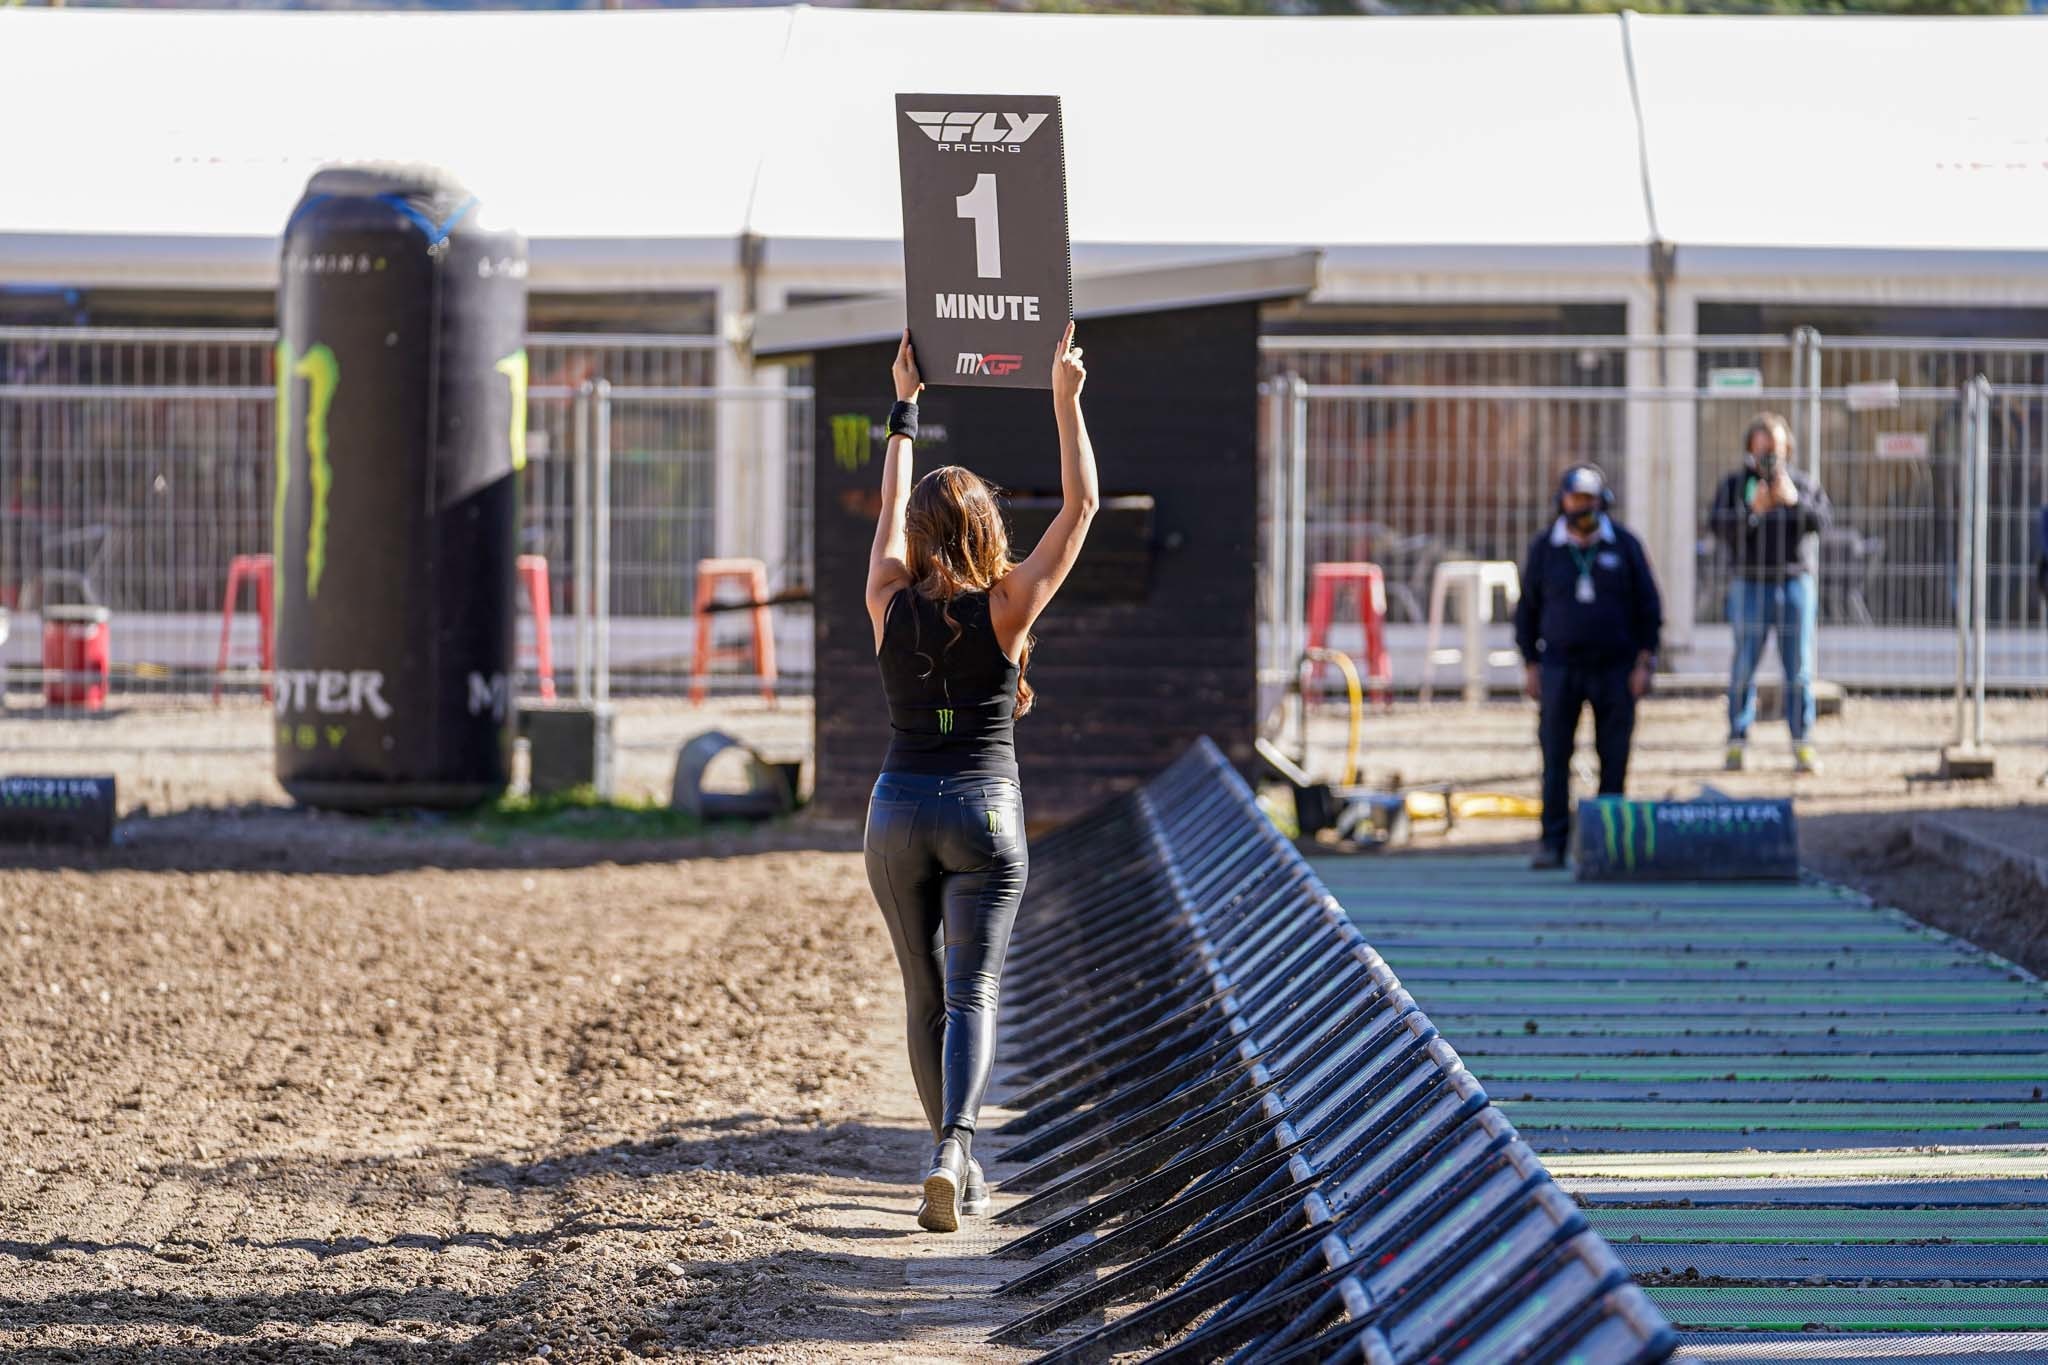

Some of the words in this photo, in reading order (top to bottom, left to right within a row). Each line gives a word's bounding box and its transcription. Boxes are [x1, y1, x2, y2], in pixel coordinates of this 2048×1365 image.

[905, 111, 1049, 143] FLY
[937, 143, 1021, 153] RACING
[955, 173, 1002, 279] 1
[935, 293, 1041, 321] MINUTE
[955, 352, 1024, 376] MXGP
